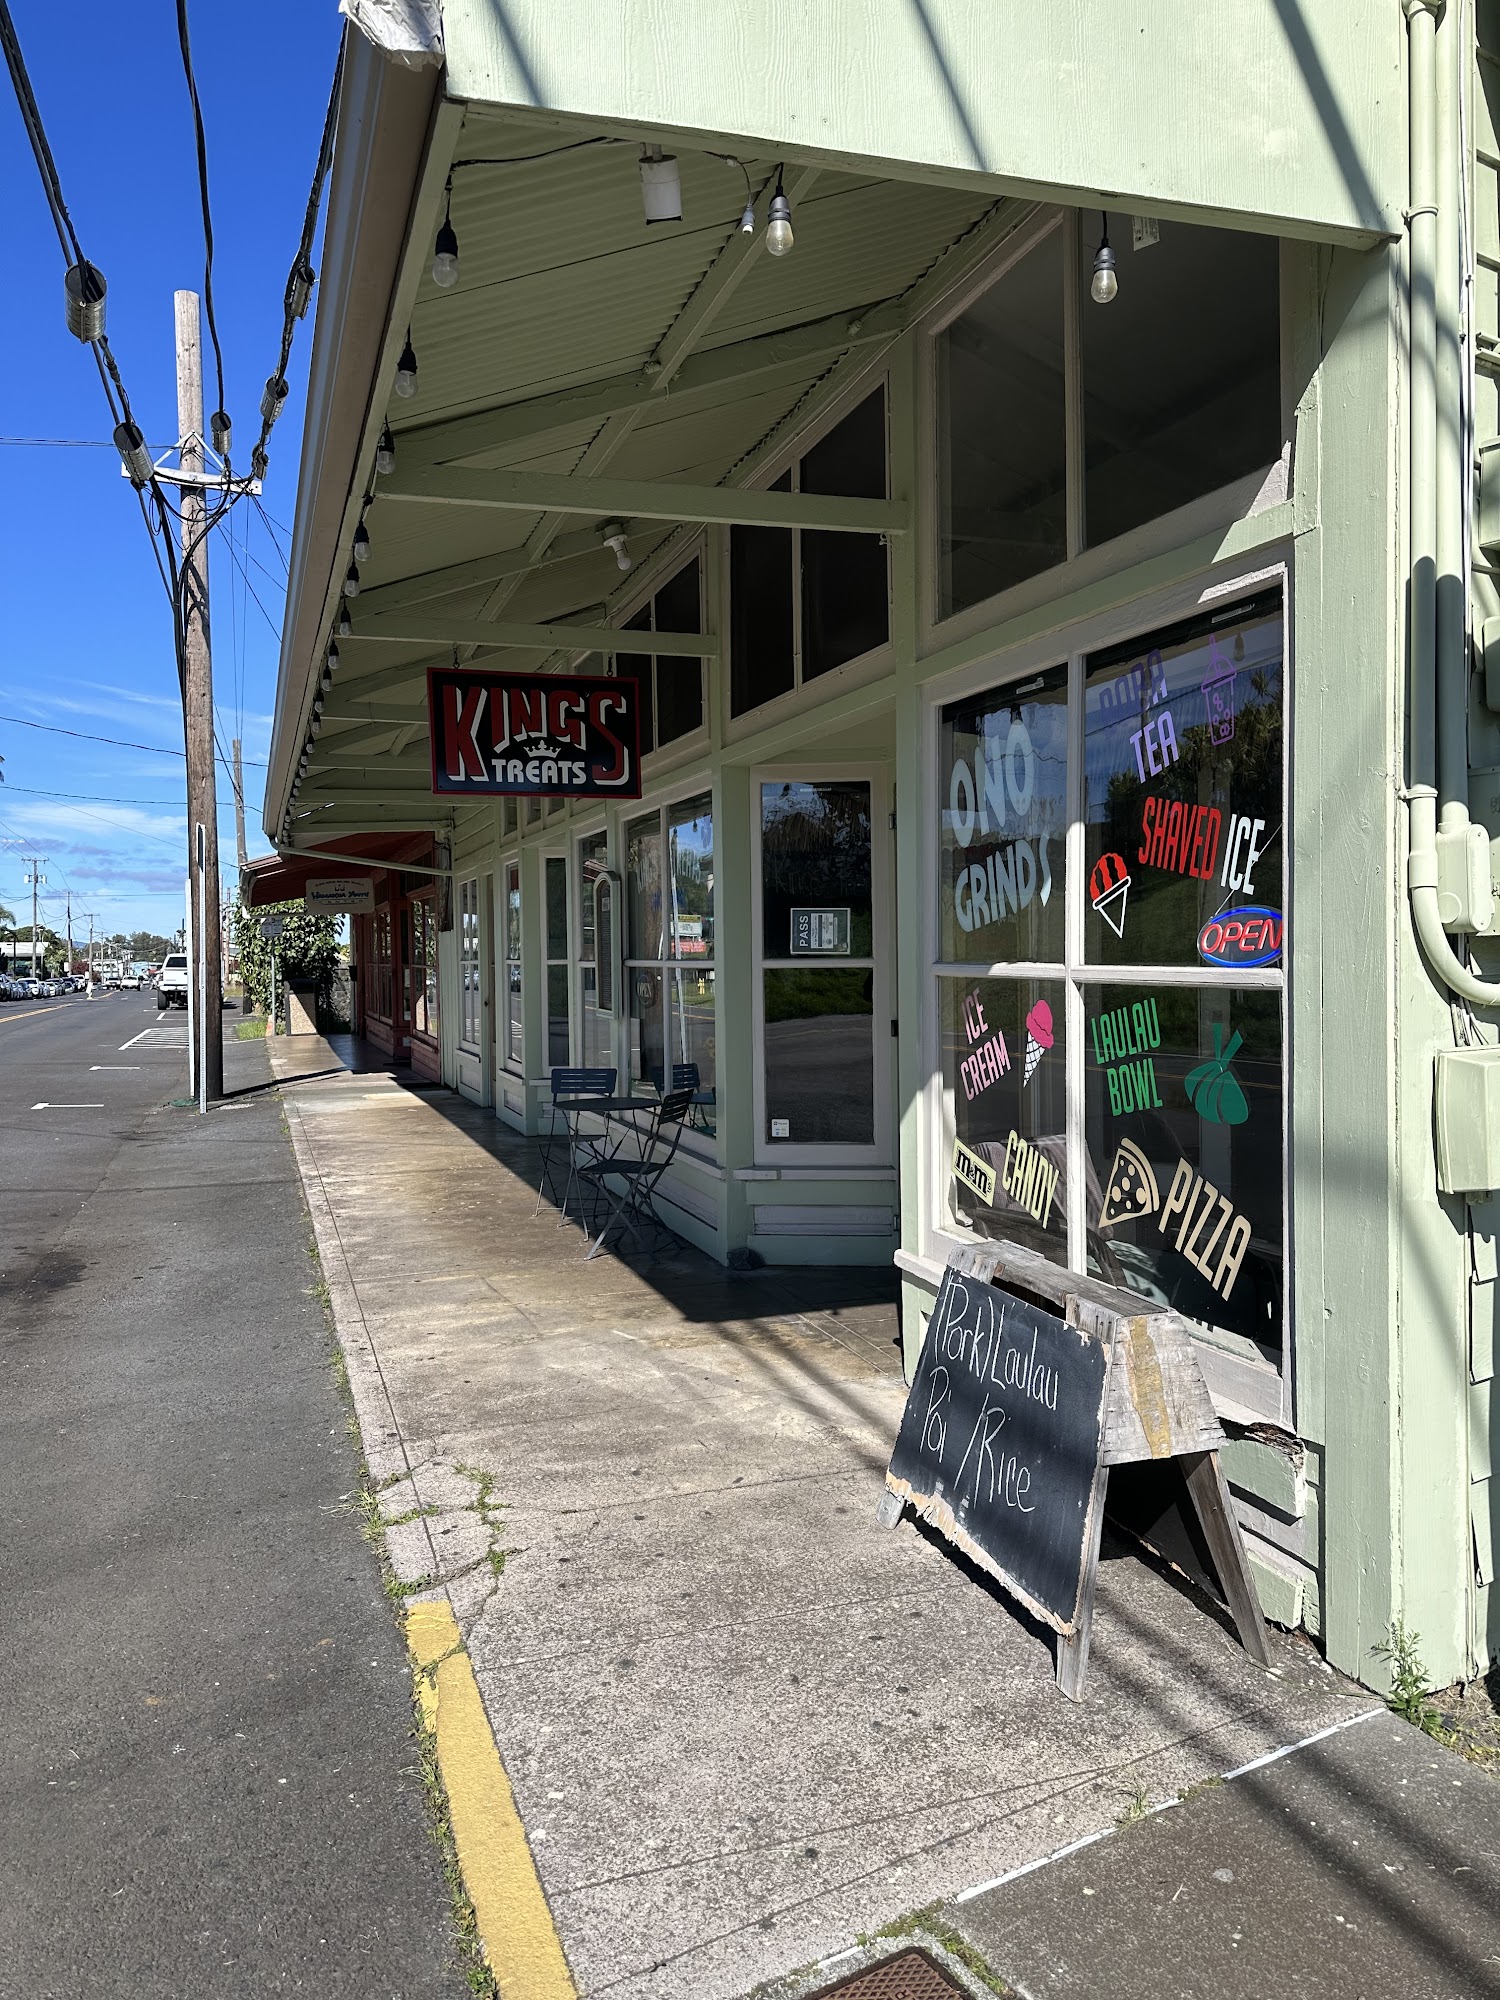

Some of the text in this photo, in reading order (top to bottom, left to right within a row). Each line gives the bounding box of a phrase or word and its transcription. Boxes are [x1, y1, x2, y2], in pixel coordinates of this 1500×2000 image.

[491, 758, 587, 785] TREATS
[1129, 710, 1180, 784] TEA
[950, 719, 1035, 849] ONO
[955, 828, 1052, 933] GRINDS
[1138, 796, 1266, 895] SHAVED ICE
[798, 914, 809, 948] PASS
[1201, 918, 1283, 954] OPEN
[961, 987, 989, 1045] ICE
[1091, 997, 1161, 1065] LAULAU
[959, 1030, 1012, 1101] CREAM
[1106, 1057, 1164, 1117] BOWL
[1001, 1129, 1060, 1230] CANDY
[1158, 1156, 1252, 1302] PIZZA
